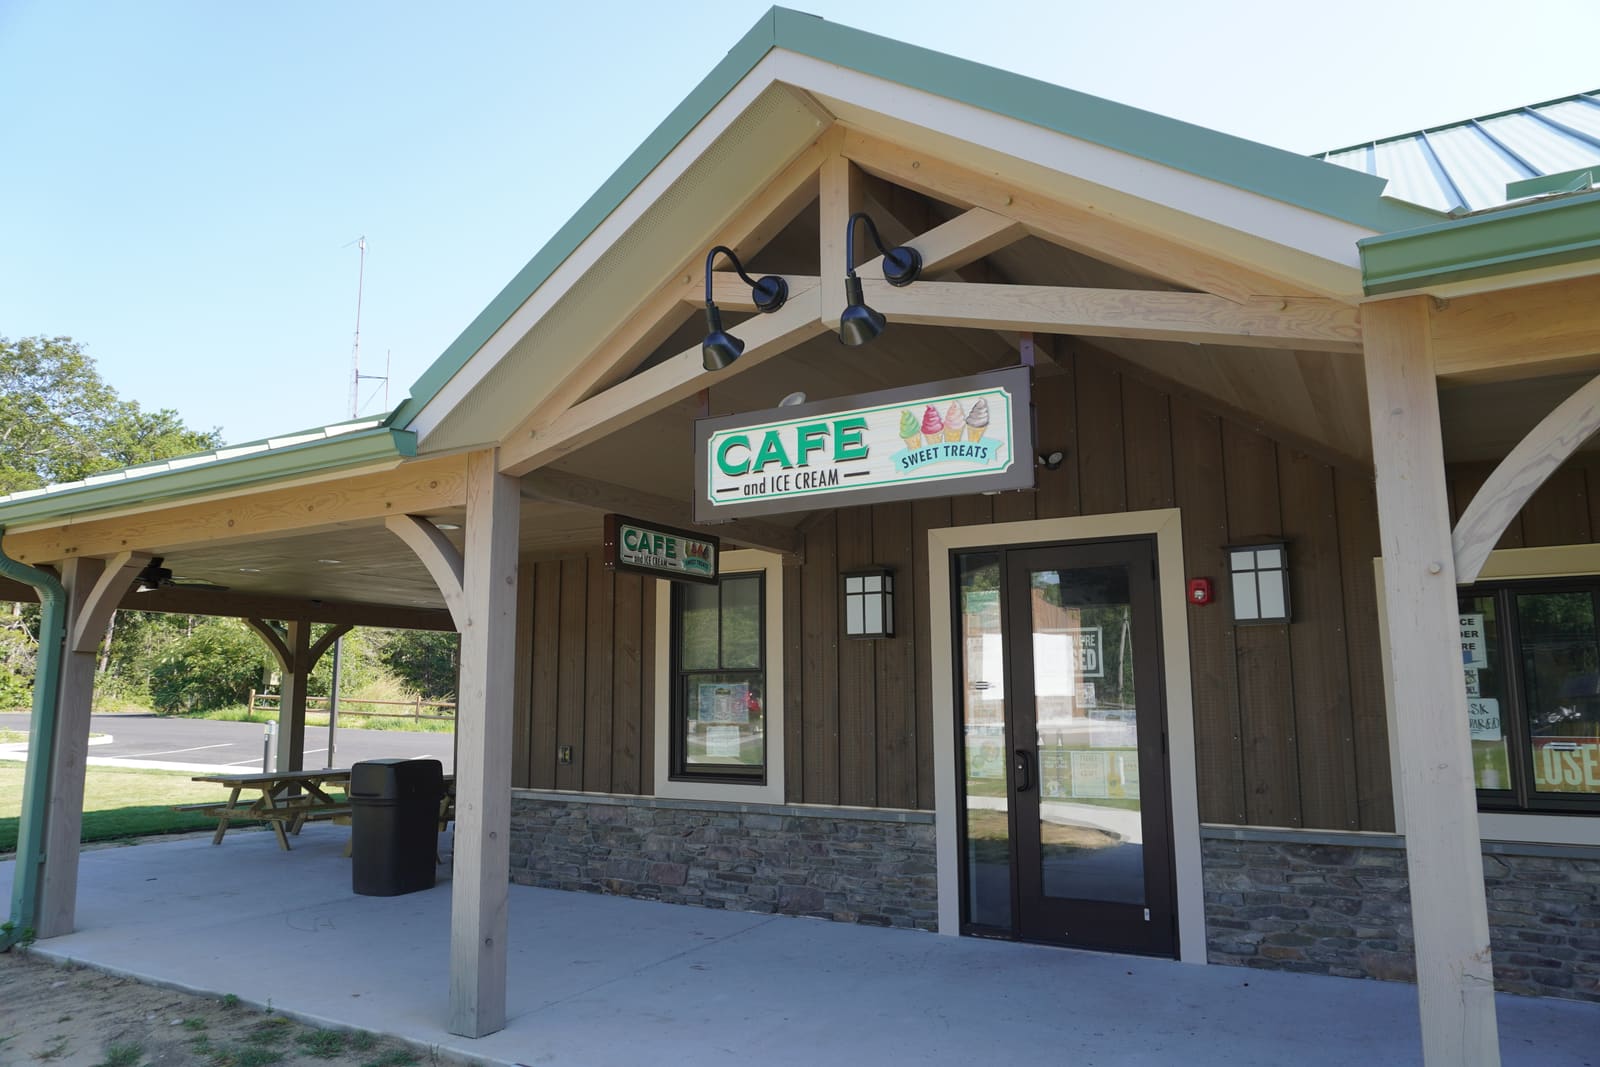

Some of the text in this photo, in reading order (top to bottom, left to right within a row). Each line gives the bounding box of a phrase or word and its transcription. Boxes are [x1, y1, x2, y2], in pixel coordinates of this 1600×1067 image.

[716, 417, 869, 477] CAFE
[901, 444, 988, 469] SWEET TREATS
[743, 468, 839, 496] and ICE CREAM
[624, 529, 677, 559] CAFE
